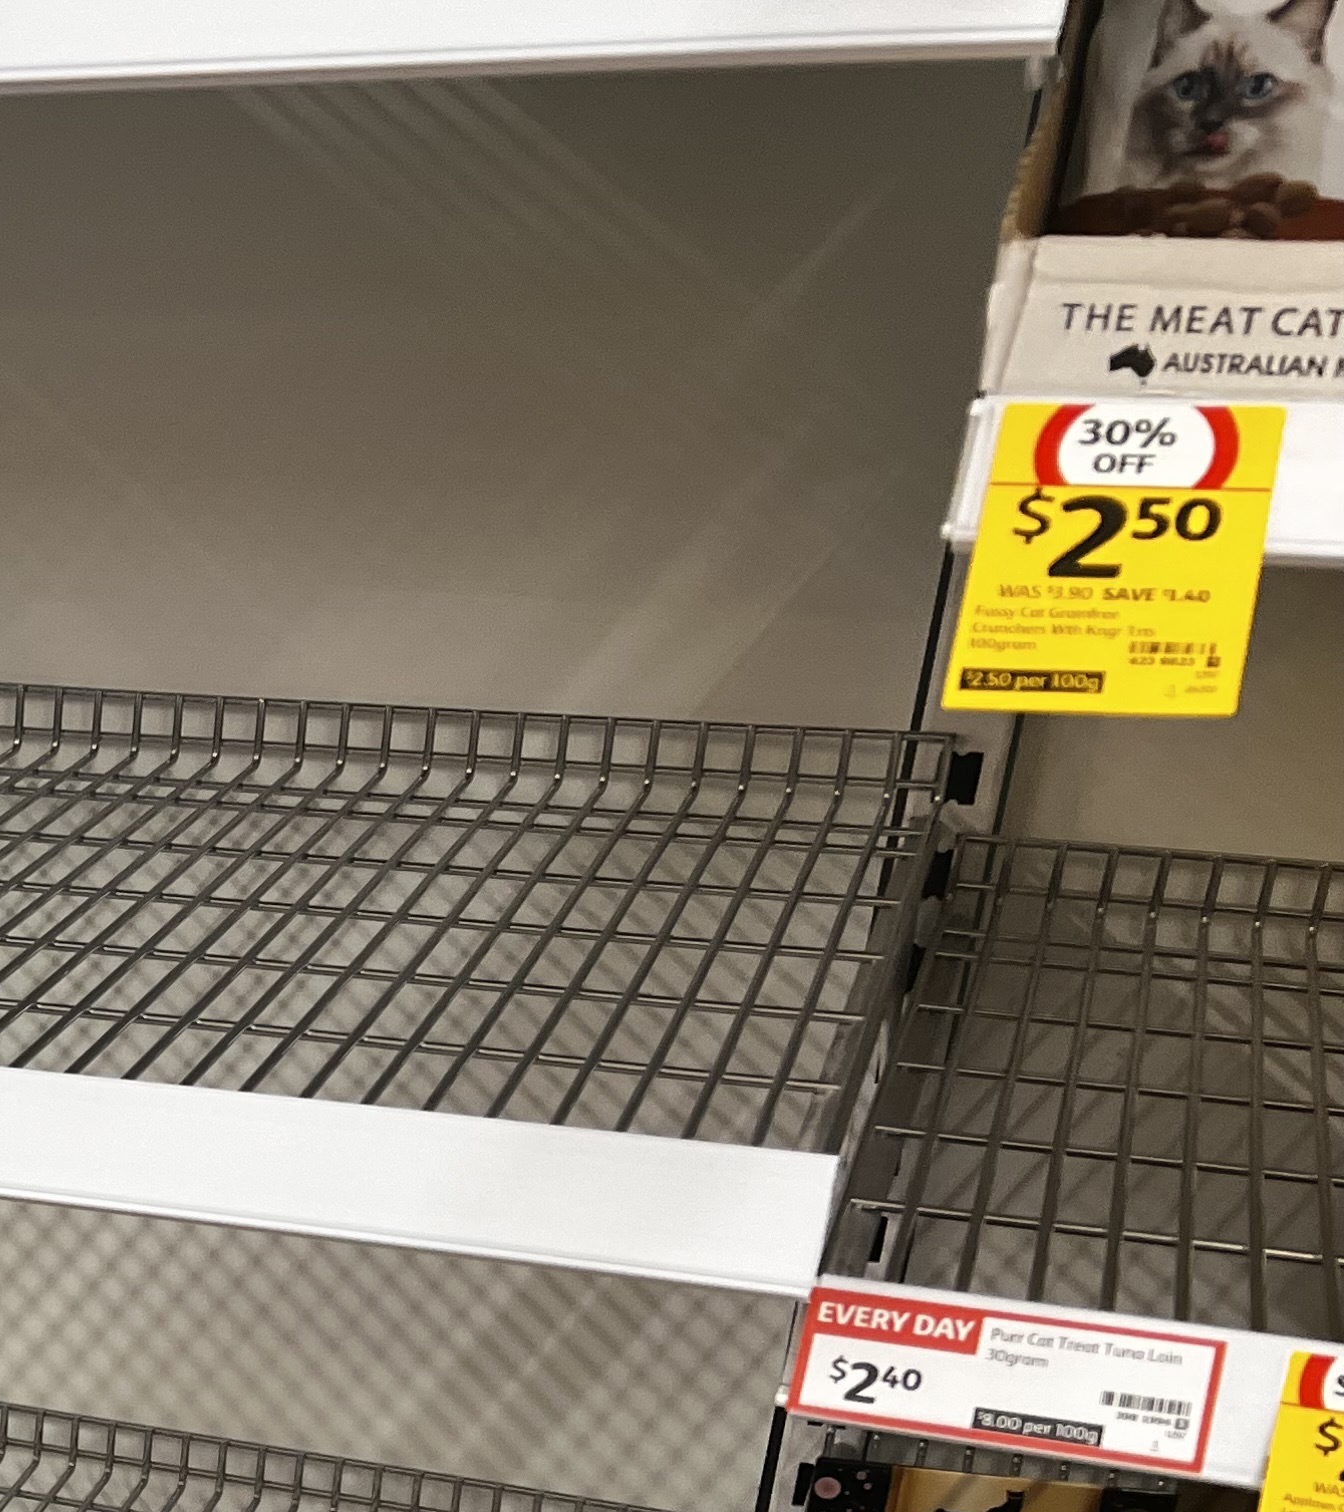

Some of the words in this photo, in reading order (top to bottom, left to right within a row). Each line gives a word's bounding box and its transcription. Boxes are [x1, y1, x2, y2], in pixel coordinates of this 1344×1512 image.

[1060, 302, 1138, 332] THE
[1150, 305, 1262, 338] MEAT
[1162, 352, 1326, 378] AUSTRALIAN
[1077, 417, 1177, 448] 30%
[1092, 453, 1155, 474] OFF
[817, 1302, 911, 1332] EVERY
[914, 1315, 975, 1341] DAY
